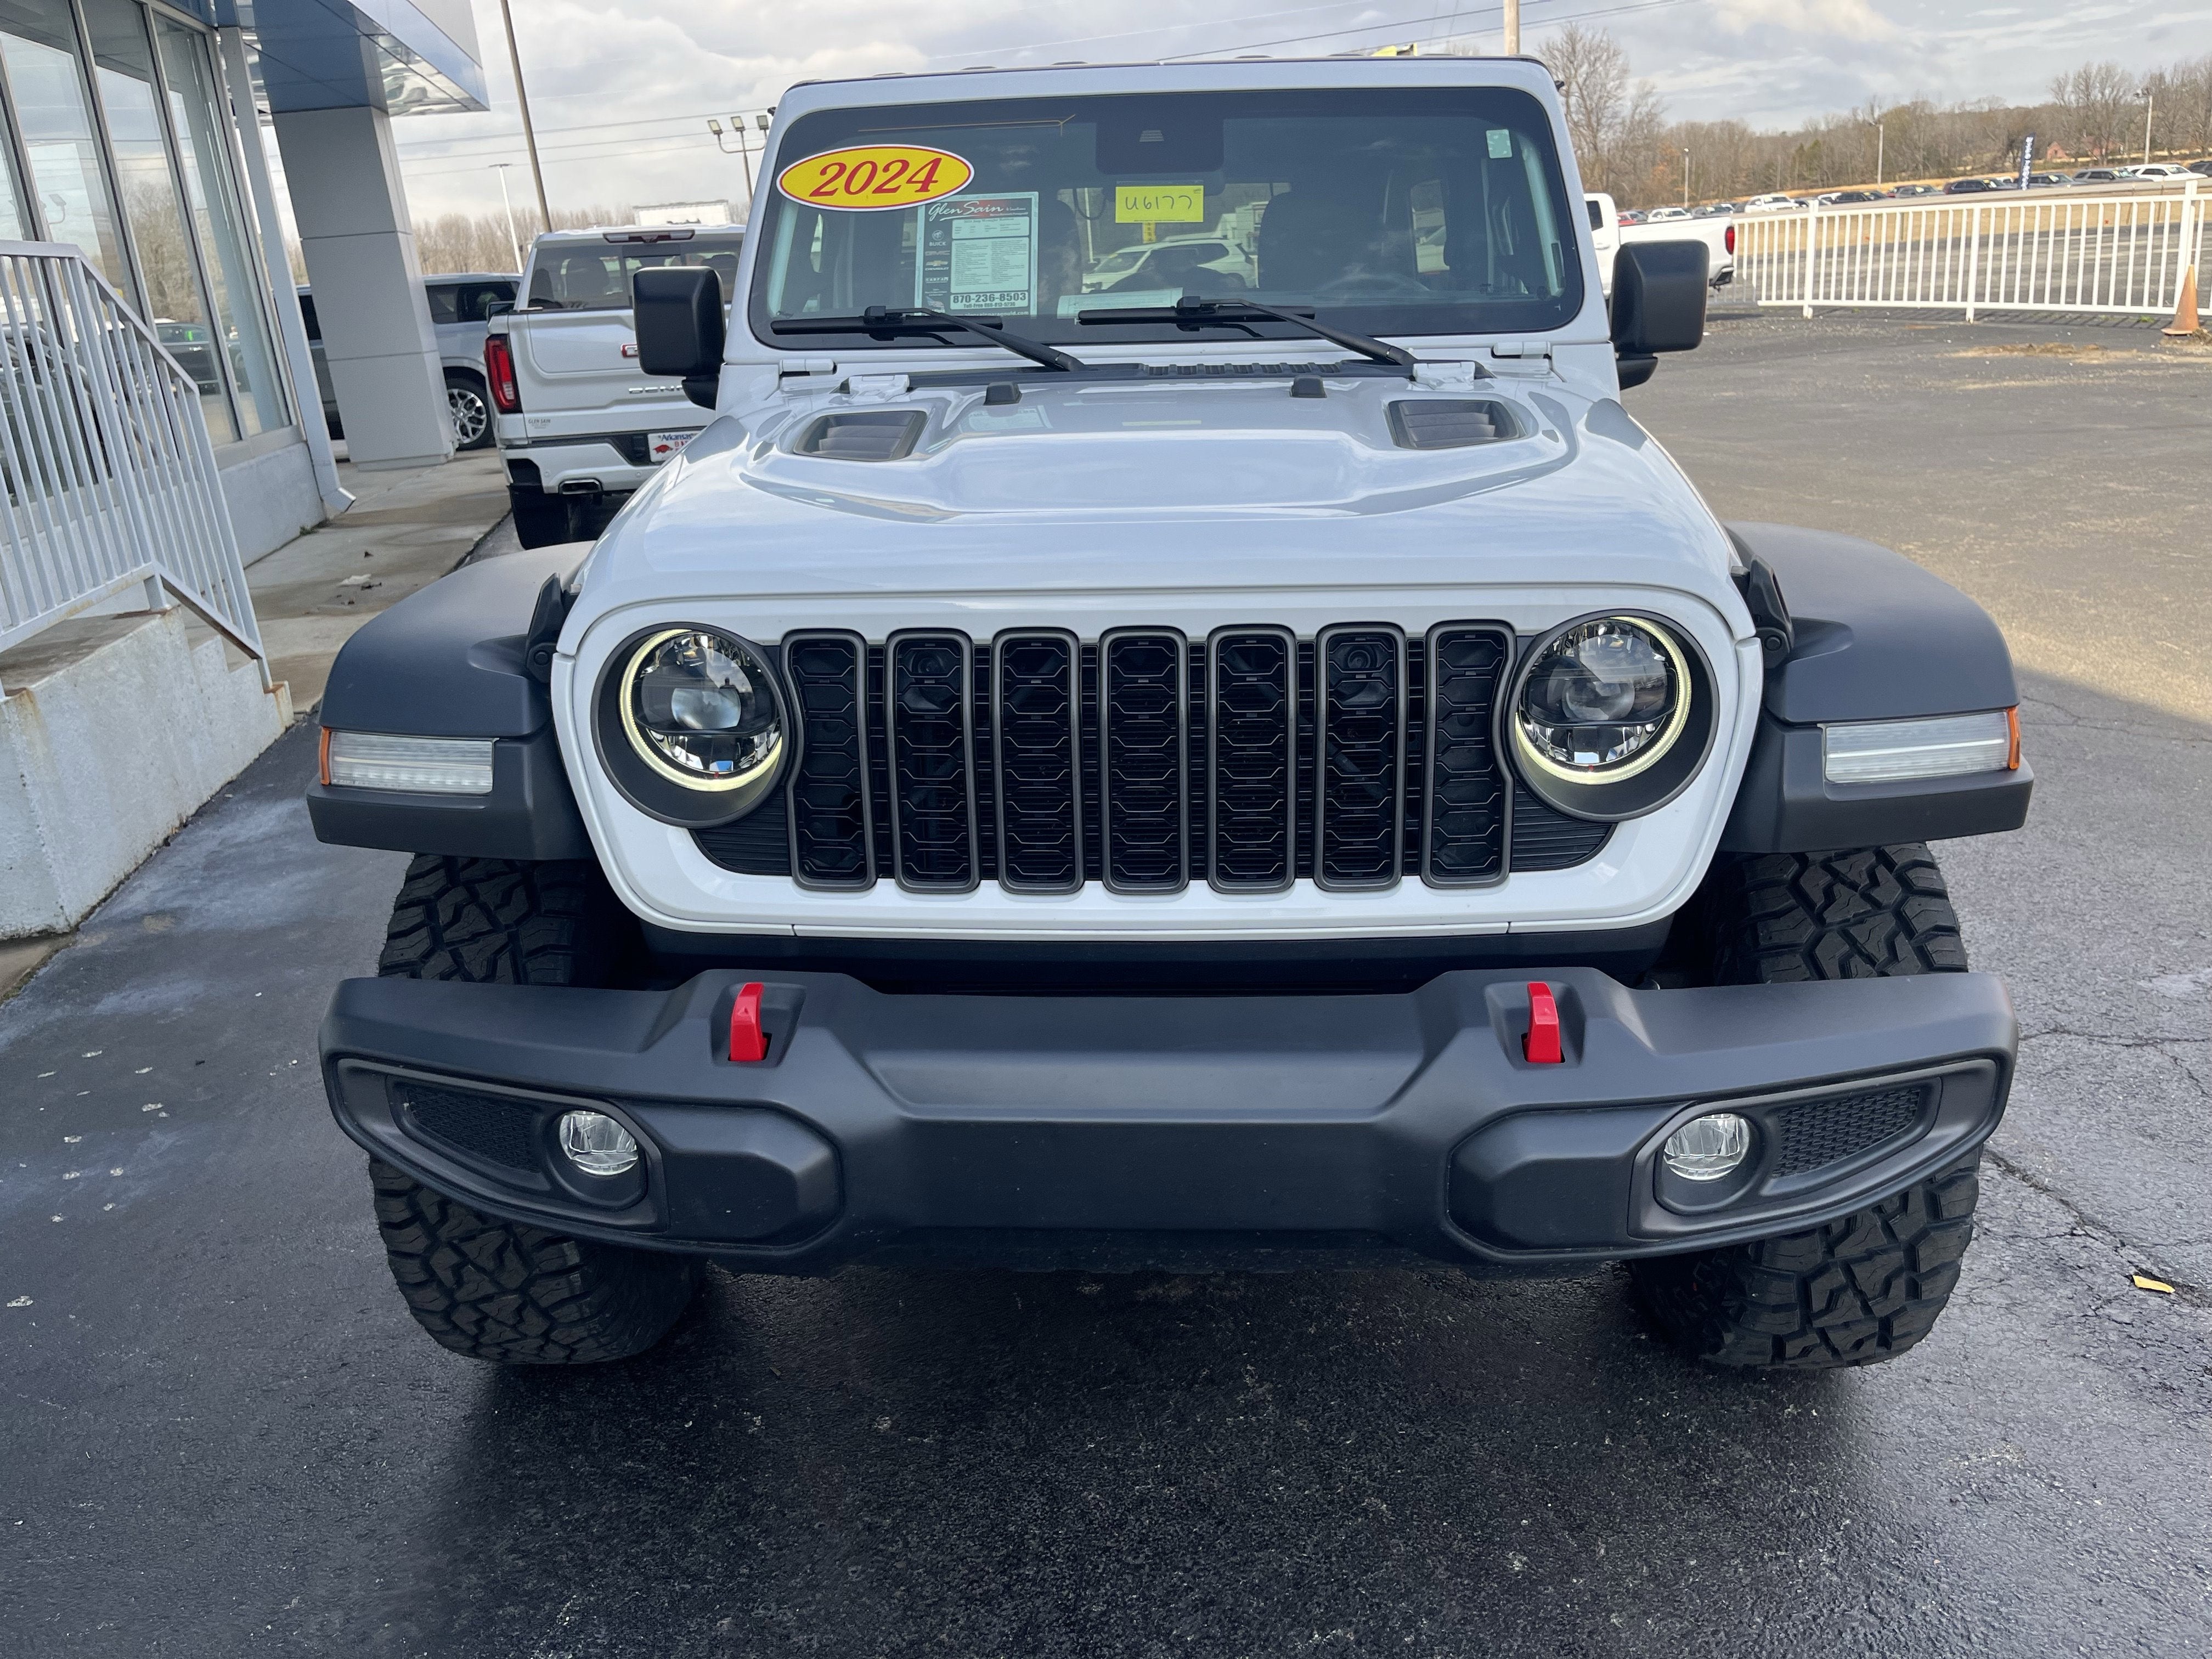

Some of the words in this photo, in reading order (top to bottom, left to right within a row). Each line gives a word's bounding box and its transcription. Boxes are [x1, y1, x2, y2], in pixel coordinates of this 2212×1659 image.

[809, 157, 943, 197] 2024
[928, 202, 963, 222] Glen
[963, 201, 1005, 215] Sain
[953, 292, 1026, 303] 870-236-8503
[661, 433, 692, 442] Arkansas
